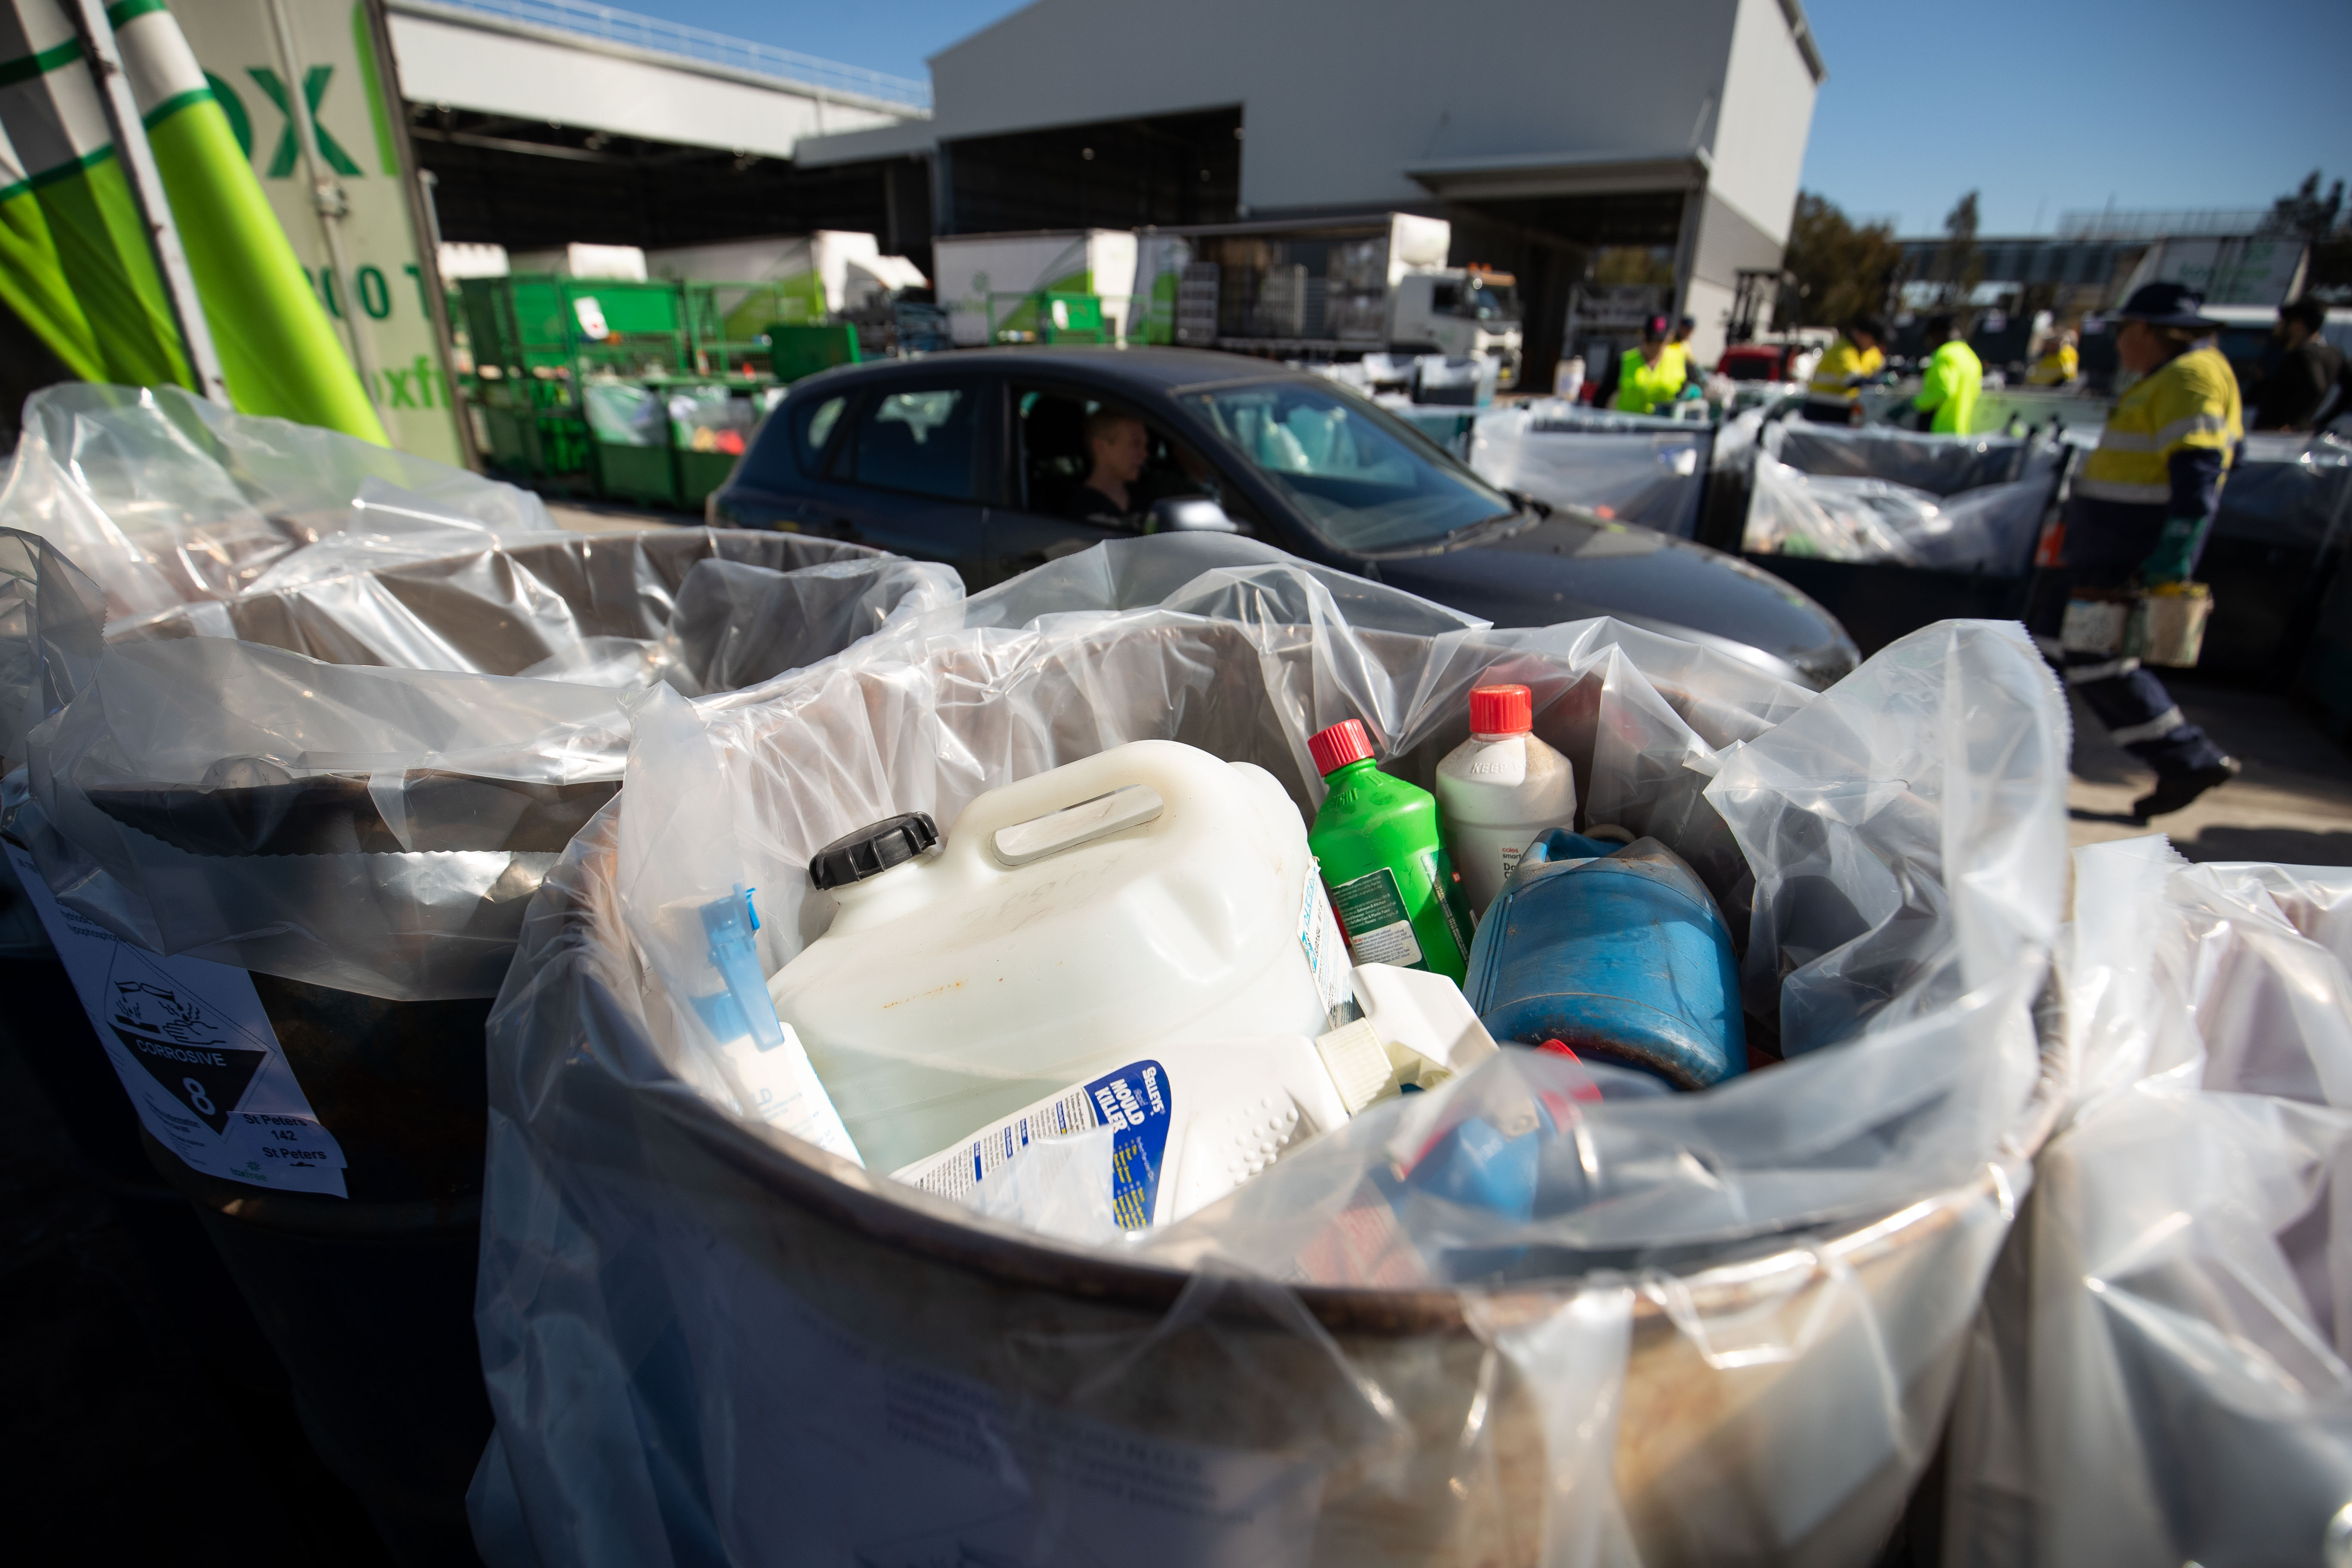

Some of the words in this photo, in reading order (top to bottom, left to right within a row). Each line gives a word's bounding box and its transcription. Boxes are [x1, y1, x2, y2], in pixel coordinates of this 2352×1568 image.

[1471, 762, 1507, 774] KEEP
[135, 1038, 227, 1066] CORROSIVE
[182, 1077, 217, 1116] 8
[1142, 1066, 1165, 1113] SELLEYS
[1094, 1086, 1128, 1134] KILLER
[1109, 1078, 1145, 1125] MOULD
[243, 1114, 260, 1124] St
[260, 1115, 307, 1127] Peters
[271, 1130, 297, 1141] 142
[262, 1147, 279, 1158] St
[279, 1148, 327, 1160] Peters
[230, 1167, 268, 1182] toxfree
